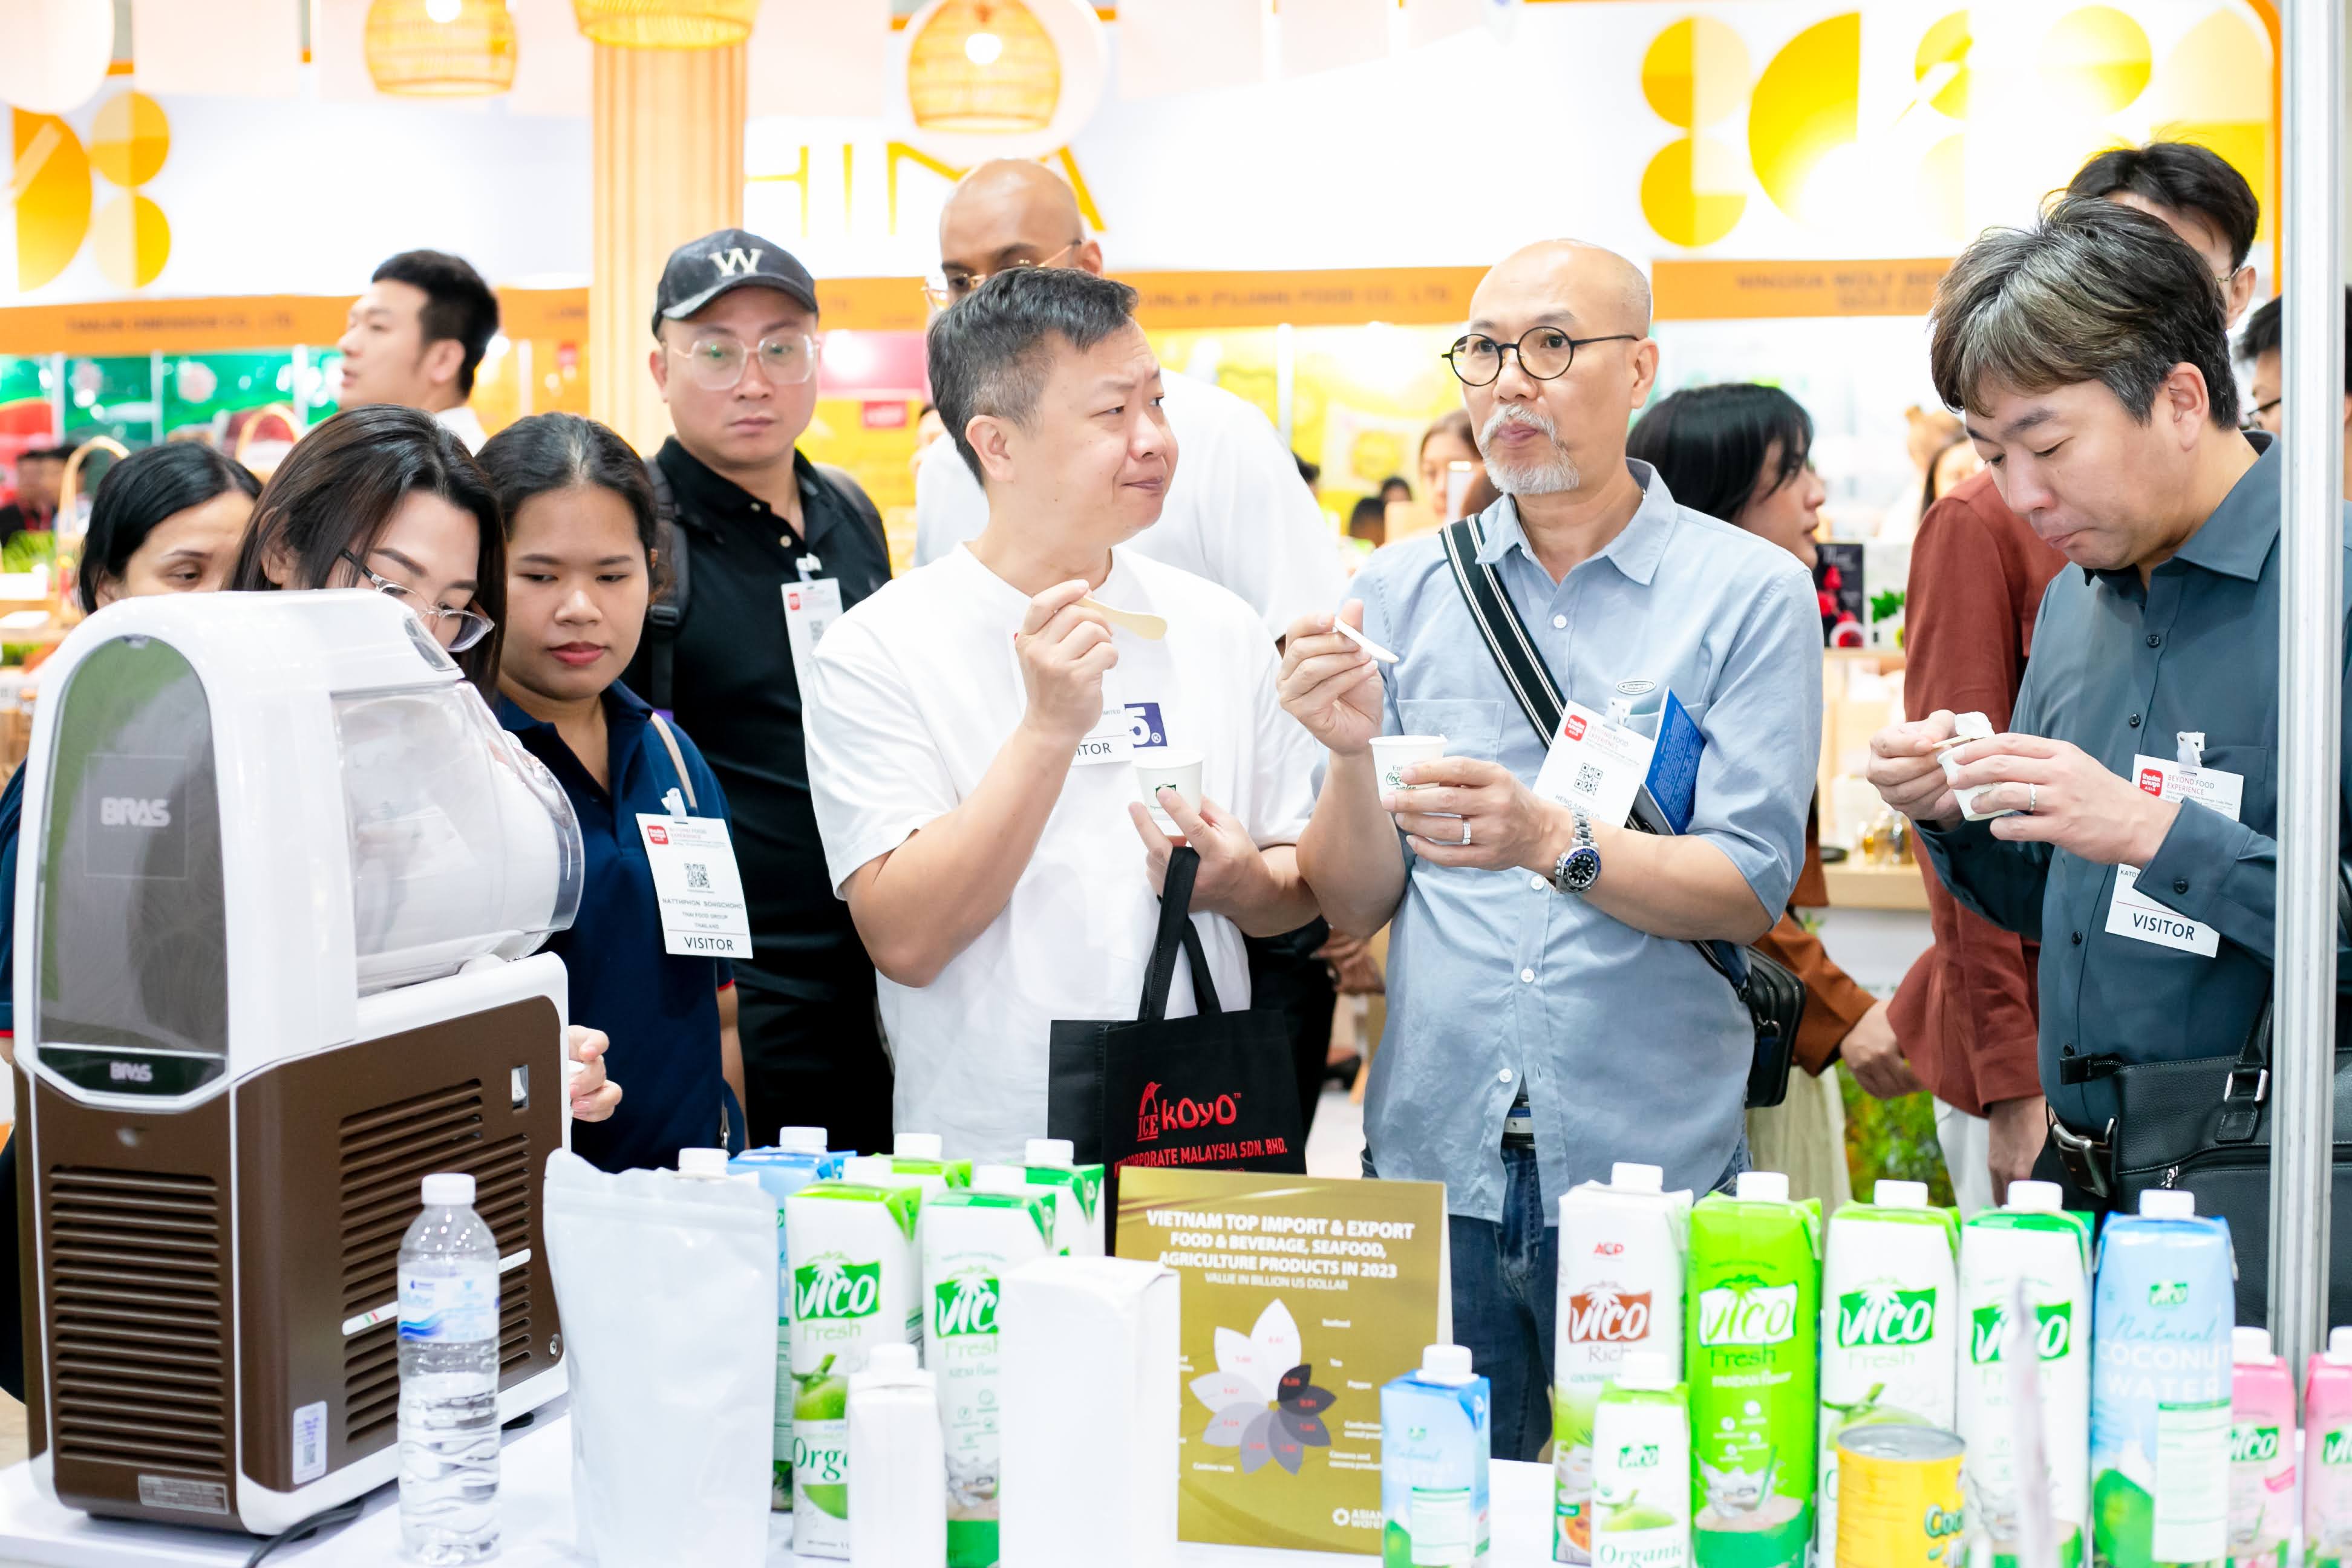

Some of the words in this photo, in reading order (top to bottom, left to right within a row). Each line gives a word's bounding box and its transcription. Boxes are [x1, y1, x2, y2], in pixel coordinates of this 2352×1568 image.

[707, 247, 764, 276] W
[2167, 782, 2205, 795] EXPERIENCE
[2168, 774, 2195, 785] BEYOND
[2196, 780, 2215, 789] FOOD
[100, 797, 171, 827] BRAS
[2133, 913, 2195, 941] VISITOR
[684, 936, 734, 951] VISITOR
[1137, 1114, 1158, 1138] ICE
[1180, 1143, 1238, 1164] MALAYSIA
[1240, 1138, 1265, 1158] SDN.
[1266, 1137, 1288, 1155] BHD.
[1146, 1209, 1223, 1230] VIETNAM
[1225, 1213, 1259, 1232] TOP
[1261, 1215, 1328, 1235] IMPORT
[1330, 1219, 1344, 1236] &
[1347, 1220, 1416, 1240] EXPORT
[1170, 1231, 1214, 1248] FOOD
[1215, 1233, 1228, 1249] &
[1229, 1234, 1309, 1255] BEVERAGE,
[1312, 1239, 1387, 1259] SEAFOOD,
[1159, 1250, 1258, 1271] AGRICULTURE
[1259, 1256, 1339, 1276] PRODUCTS
[1342, 1261, 1359, 1276] IN
[1361, 1262, 1397, 1278] 2023
[1204, 1272, 1236, 1285] VALUE
[1238, 1275, 1250, 1285] IN
[1250, 1275, 1290, 1287] BILLION
[1307, 1277, 1349, 1291] DOLLAR
[803, 1322, 861, 1341] Fresh
[1710, 1342, 1777, 1367] Fresh
[2099, 1339, 2231, 1371] COCONUT
[2106, 1371, 2220, 1400] WATER
